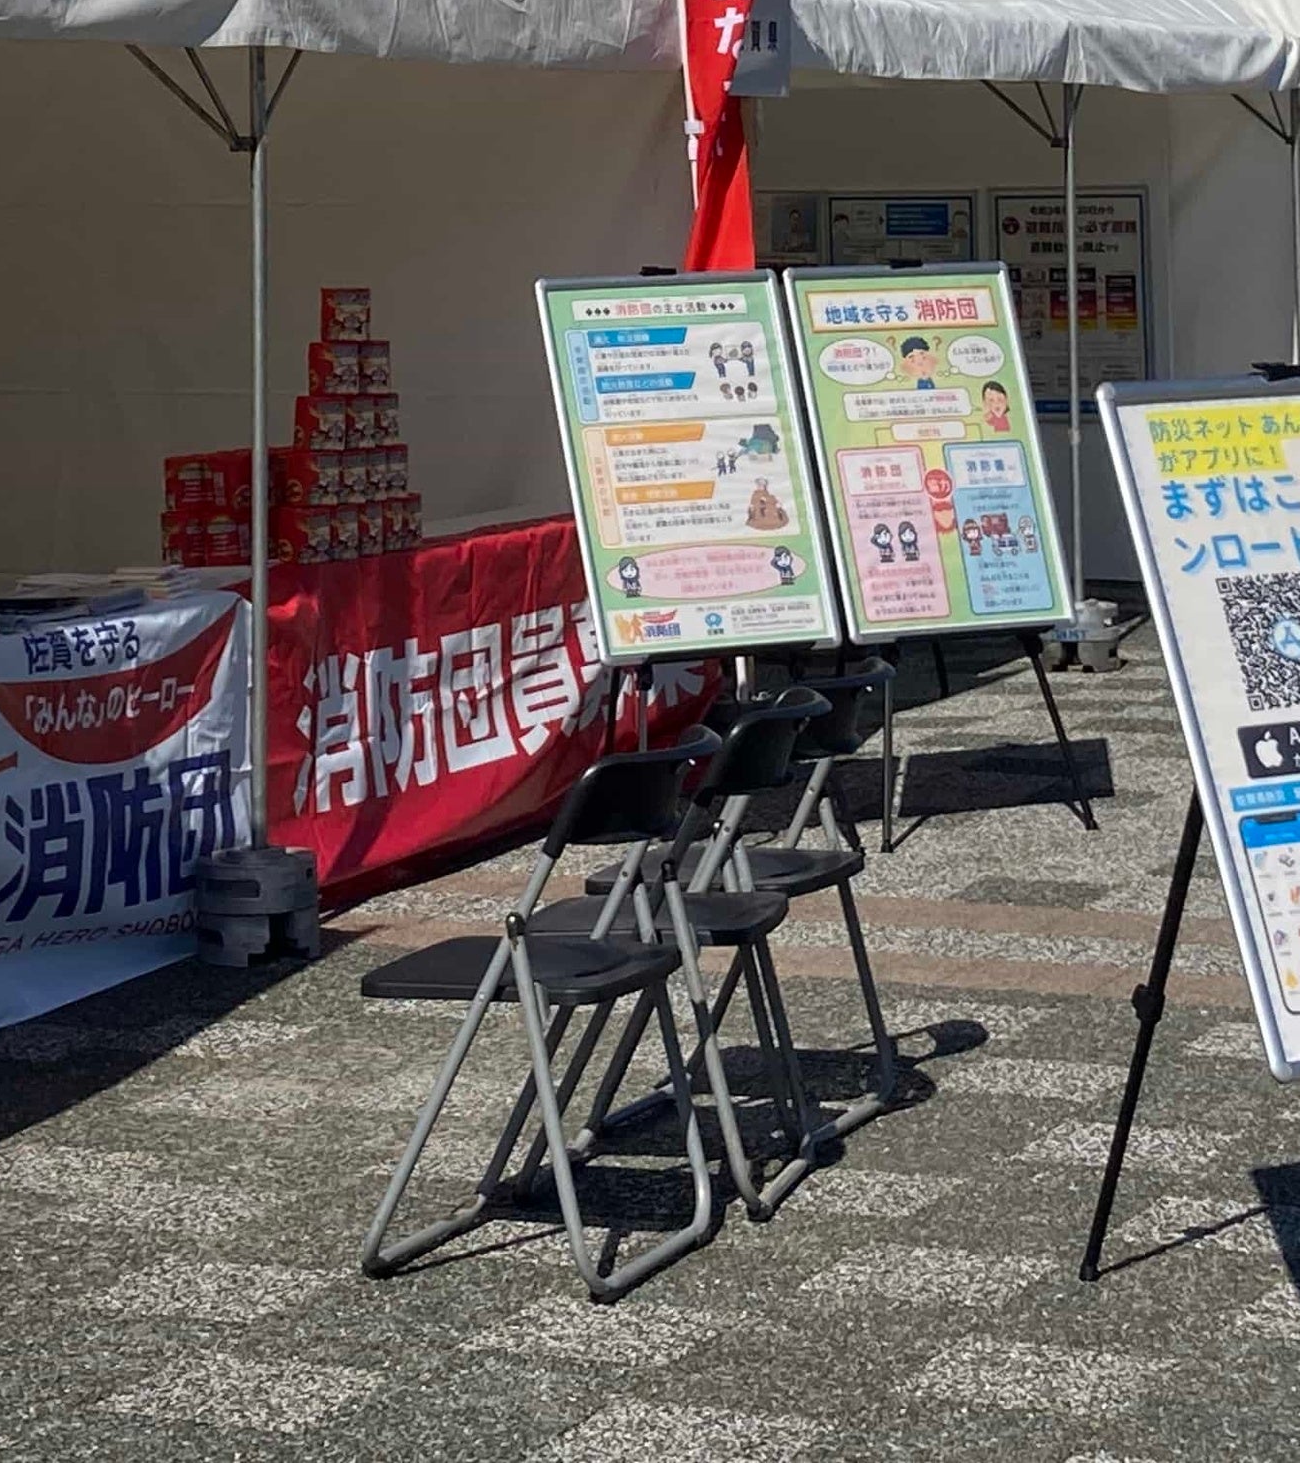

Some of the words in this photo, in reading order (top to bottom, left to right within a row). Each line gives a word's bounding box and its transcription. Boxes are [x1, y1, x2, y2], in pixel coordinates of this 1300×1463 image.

[825, 304, 909, 324] 地域を守る
[914, 297, 979, 321] 消防団
[1148, 414, 1257, 444] 防災ネット
[1157, 443, 1283, 474] がアプリに！
[23, 620, 141, 675] 佐賀を守る
[25, 676, 195, 734] 「みんな」のヒーロー
[293, 600, 705, 815] 消防団員
[114, 908, 197, 939] SHOBO
